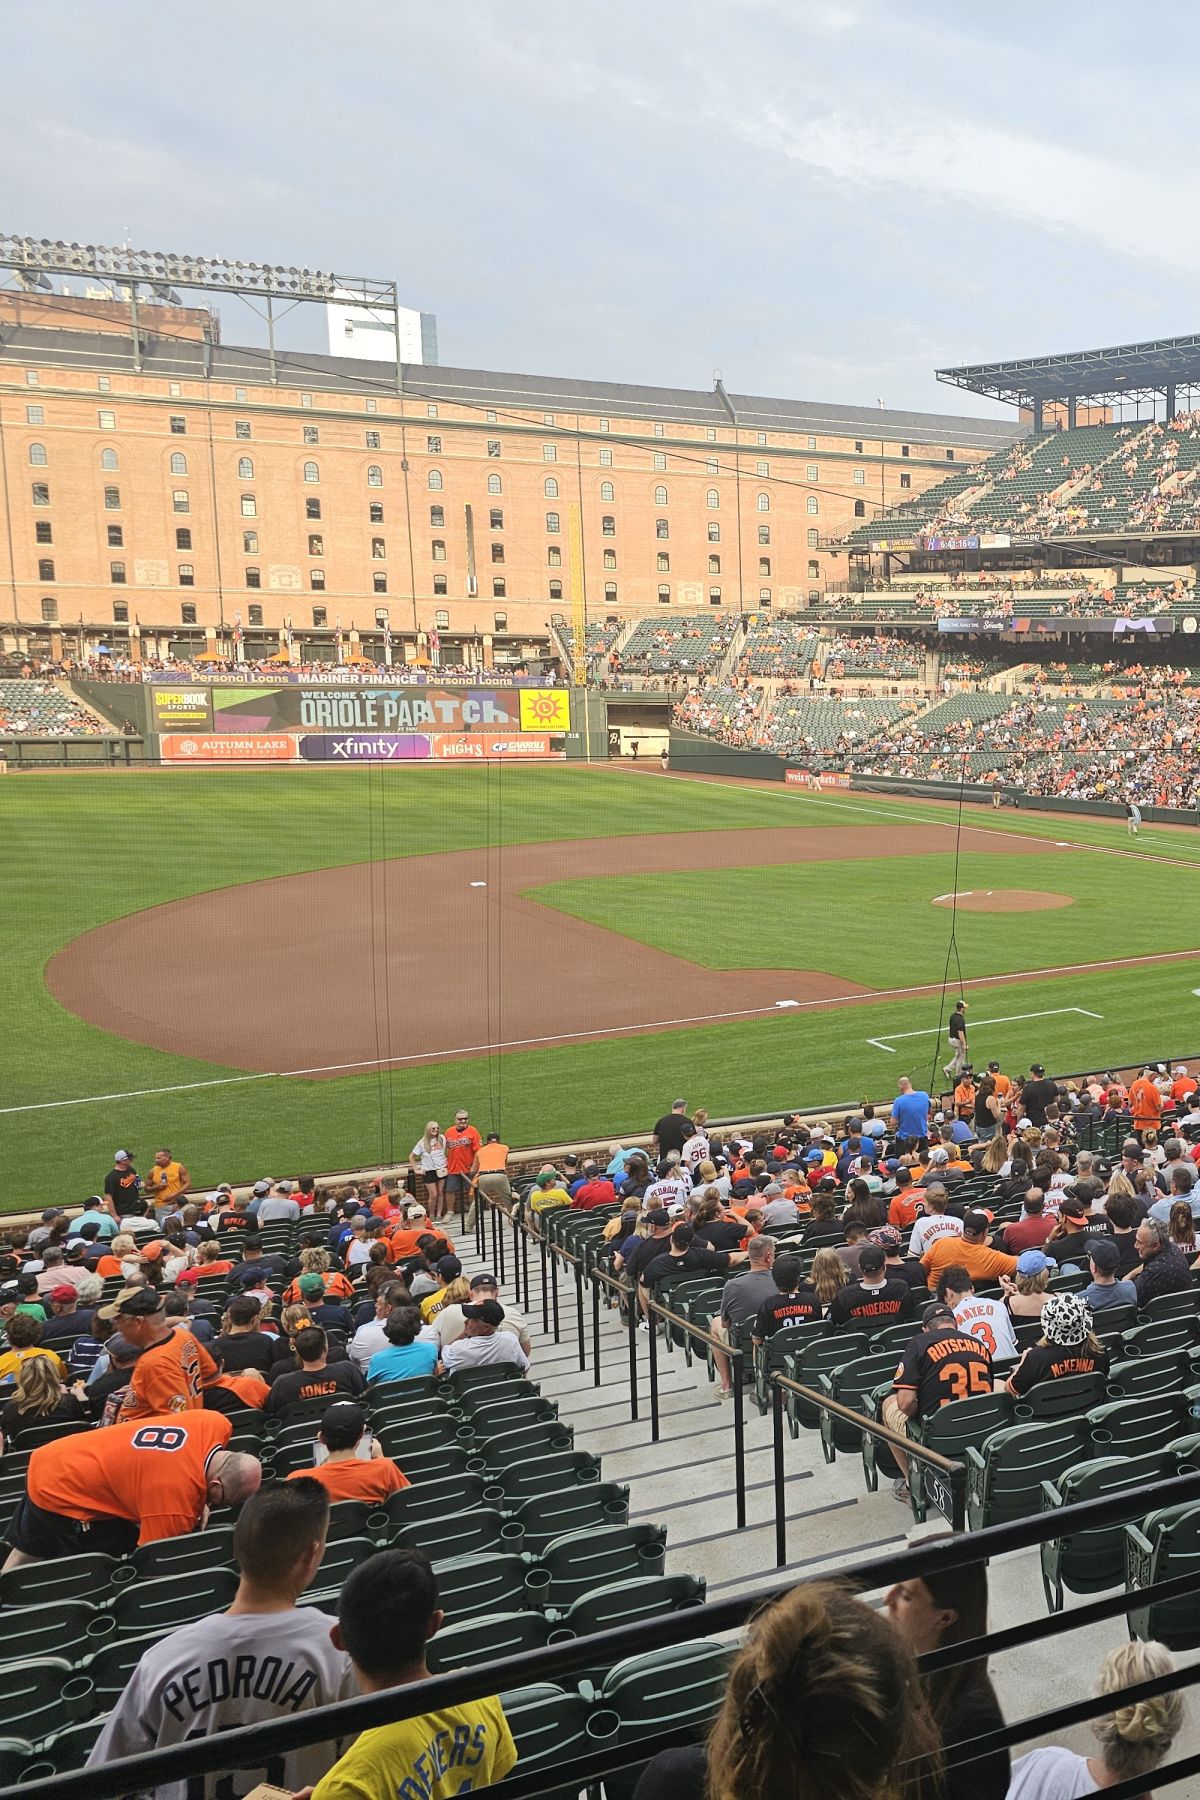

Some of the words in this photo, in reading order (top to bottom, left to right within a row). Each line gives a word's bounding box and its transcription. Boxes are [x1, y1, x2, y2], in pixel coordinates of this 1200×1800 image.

[191, 672, 248, 683] Personal
[251, 673, 289, 683] Loans
[298, 673, 360, 684] MARINER
[362, 674, 418, 684] FINANCE
[426, 675, 477, 685] Personal
[479, 676, 513, 686] Loans
[155, 692, 208, 706] SUPERBOOK
[300, 691, 357, 700] WELCOME
[360, 691, 376, 700] TO
[301, 699, 378, 727] ORIOLE
[201, 741, 254, 749] AUTUMN
[256, 741, 288, 749] LAKE
[332, 737, 399, 759] xfinity
[443, 743, 483, 756] HIGH'S
[507, 741, 545, 750] CARROLL
[787, 772, 805, 782] weis
[690, 1147, 706, 1162] 36
[223, 1216, 248, 1226] RIPKEN
[774, 1304, 813, 1319] RUTSCHMAN
[850, 1300, 902, 1318] HENDERSON
[956, 1305, 995, 1326] MATEO
[970, 1321, 997, 1356] 3
[927, 1338, 991, 1364] RUTSCHMA
[1051, 1358, 1095, 1378] McKENNA
[299, 1380, 337, 1400] JONES
[939, 1362, 992, 1406] 35
[131, 1425, 188, 1452] 8
[162, 1655, 318, 1723] PEDROIA
